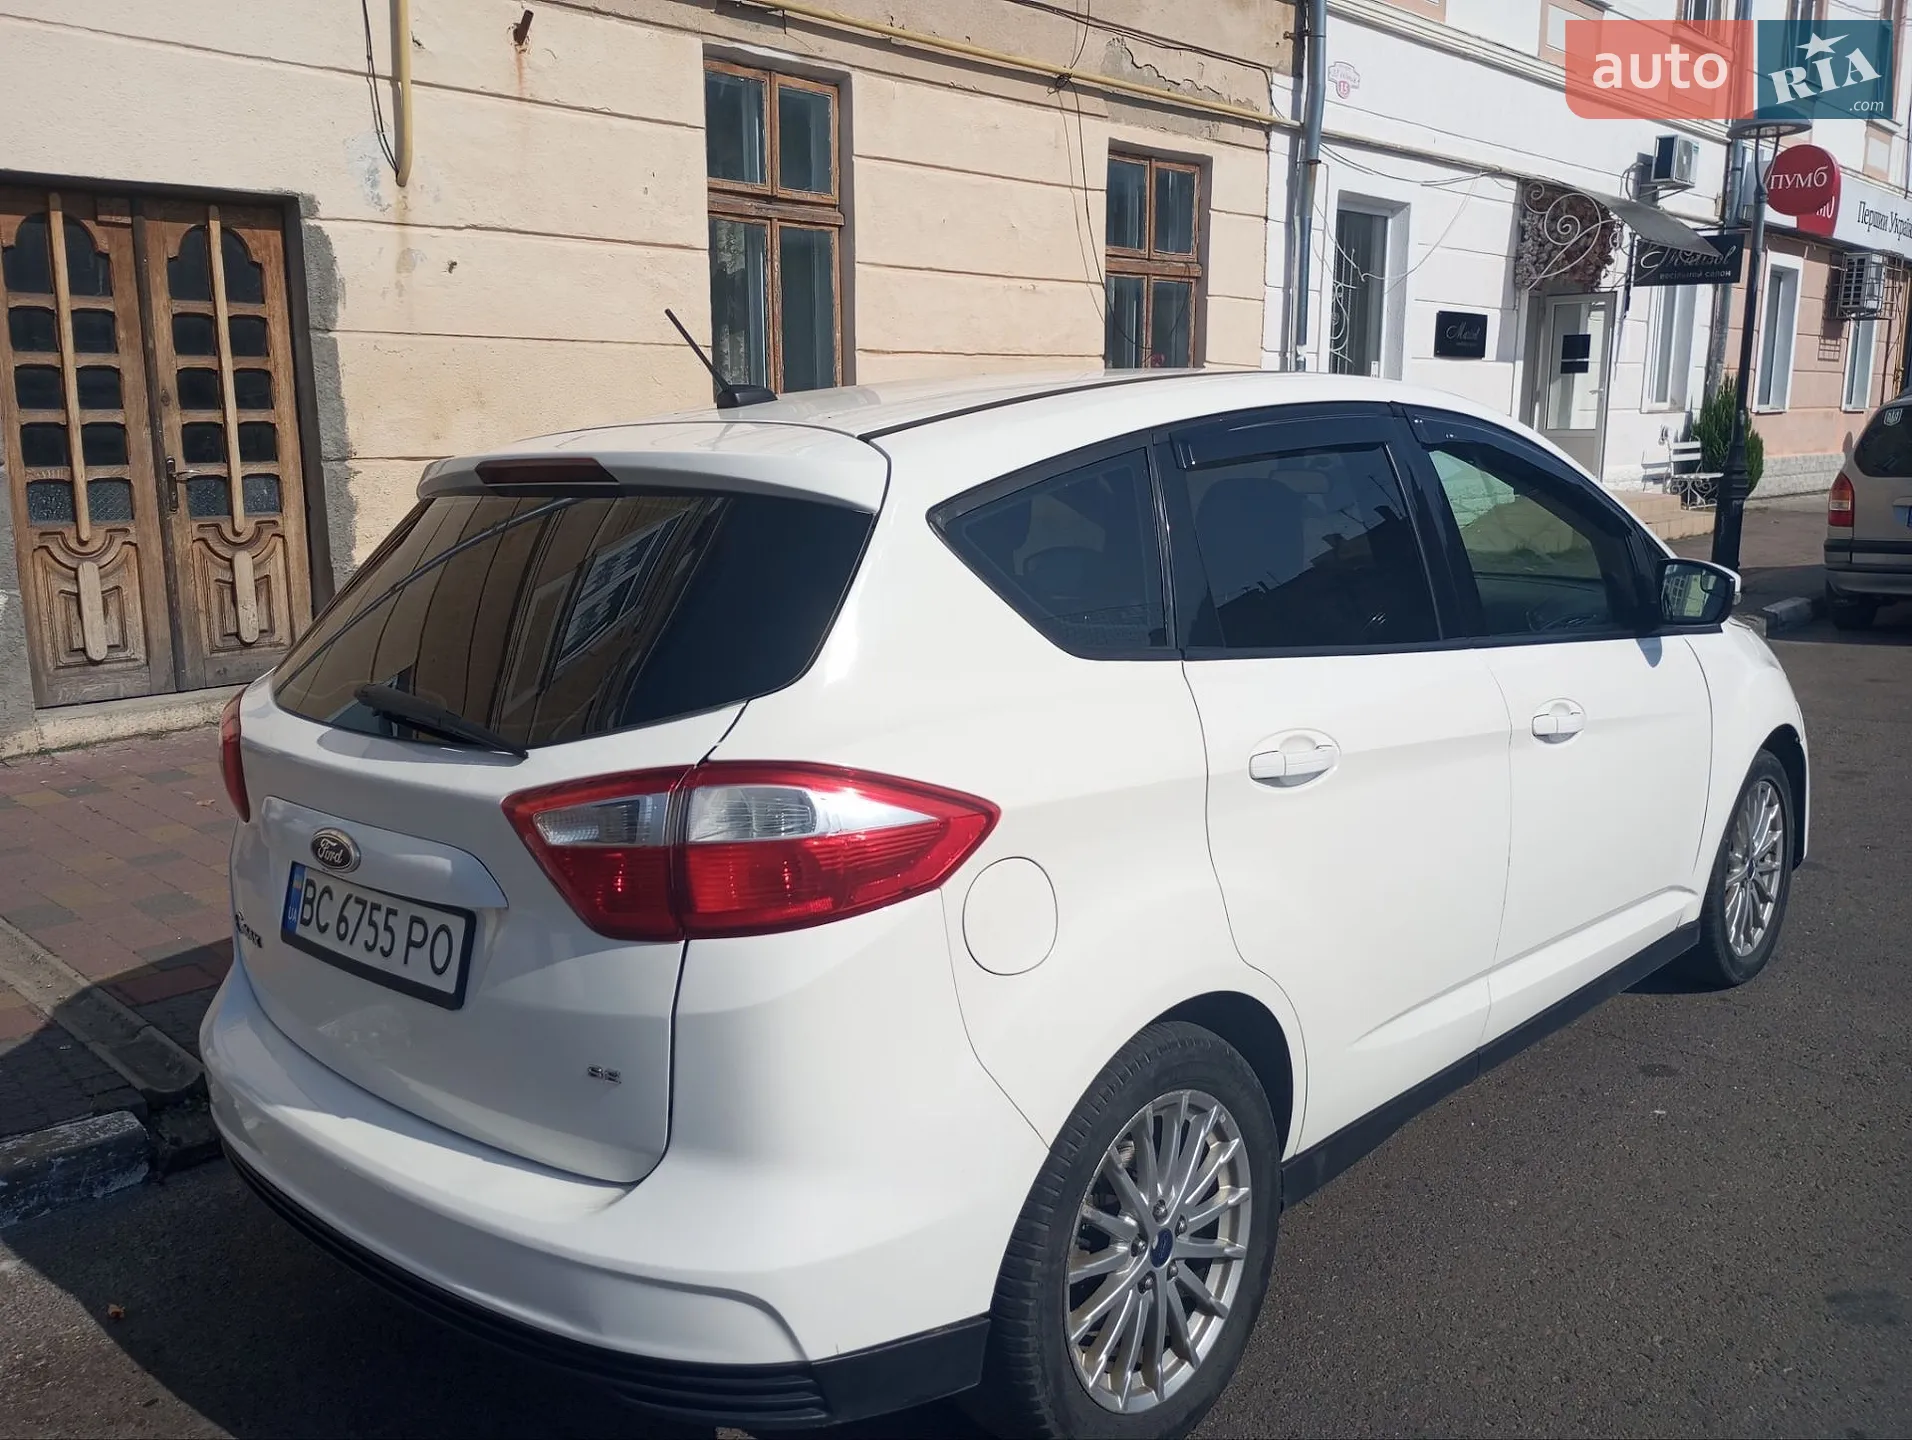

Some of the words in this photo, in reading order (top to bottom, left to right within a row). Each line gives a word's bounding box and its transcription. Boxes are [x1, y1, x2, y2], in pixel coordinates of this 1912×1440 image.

[317, 837, 343, 864] Ford
[288, 906, 298, 922] UA
[299, 878, 334, 934] BC
[336, 893, 399, 958] 6755
[403, 914, 454, 976] PO
